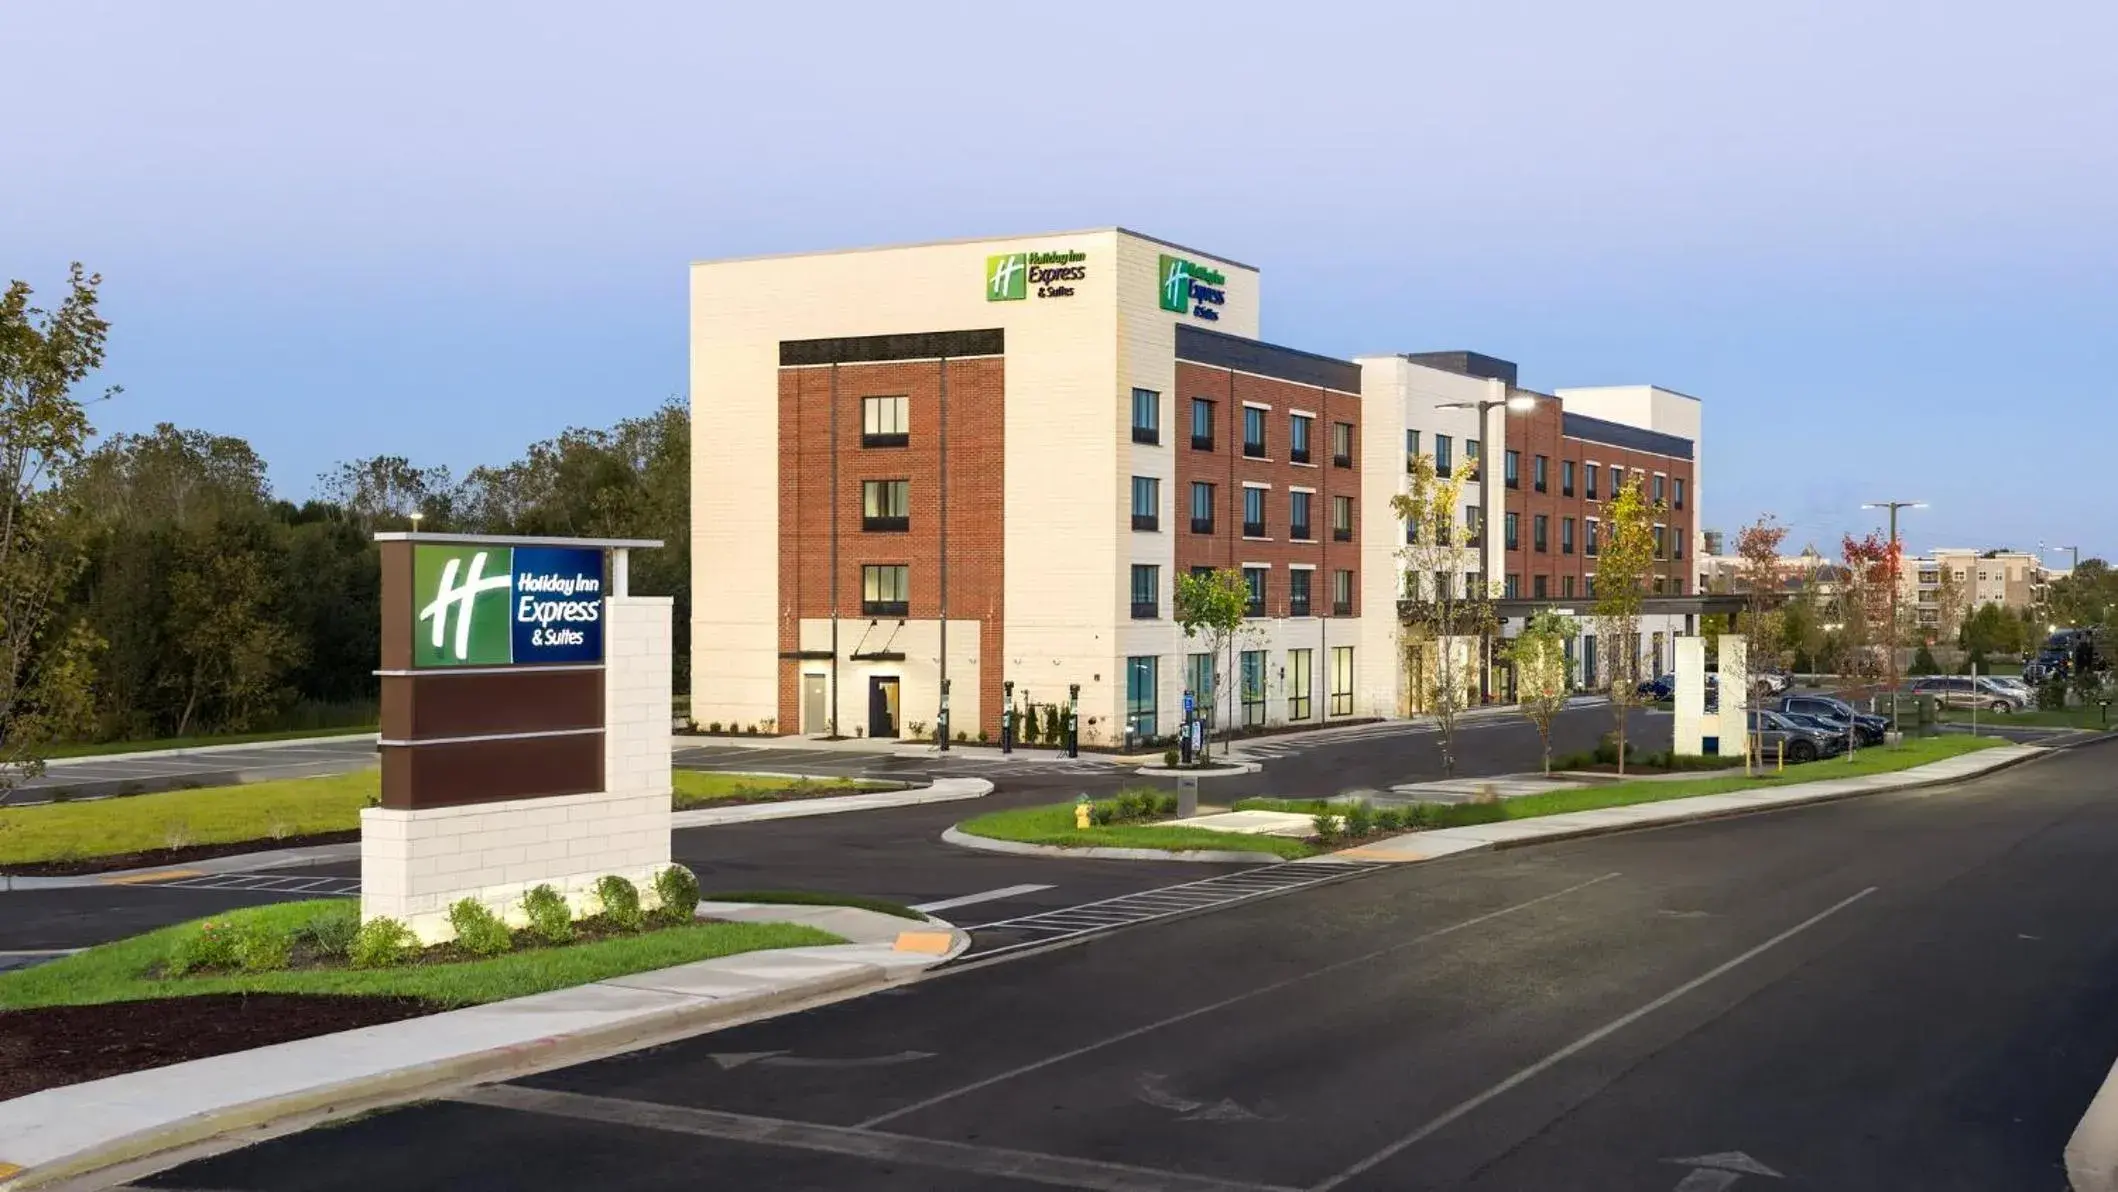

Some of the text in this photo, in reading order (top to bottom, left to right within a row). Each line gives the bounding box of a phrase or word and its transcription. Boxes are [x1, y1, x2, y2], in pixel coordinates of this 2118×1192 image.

[1028, 266, 1086, 285] Express
[1037, 286, 1075, 298] & Suites
[518, 572, 600, 596] Holiday Inn
[518, 595, 599, 628] Express
[531, 628, 584, 646] & Suites
